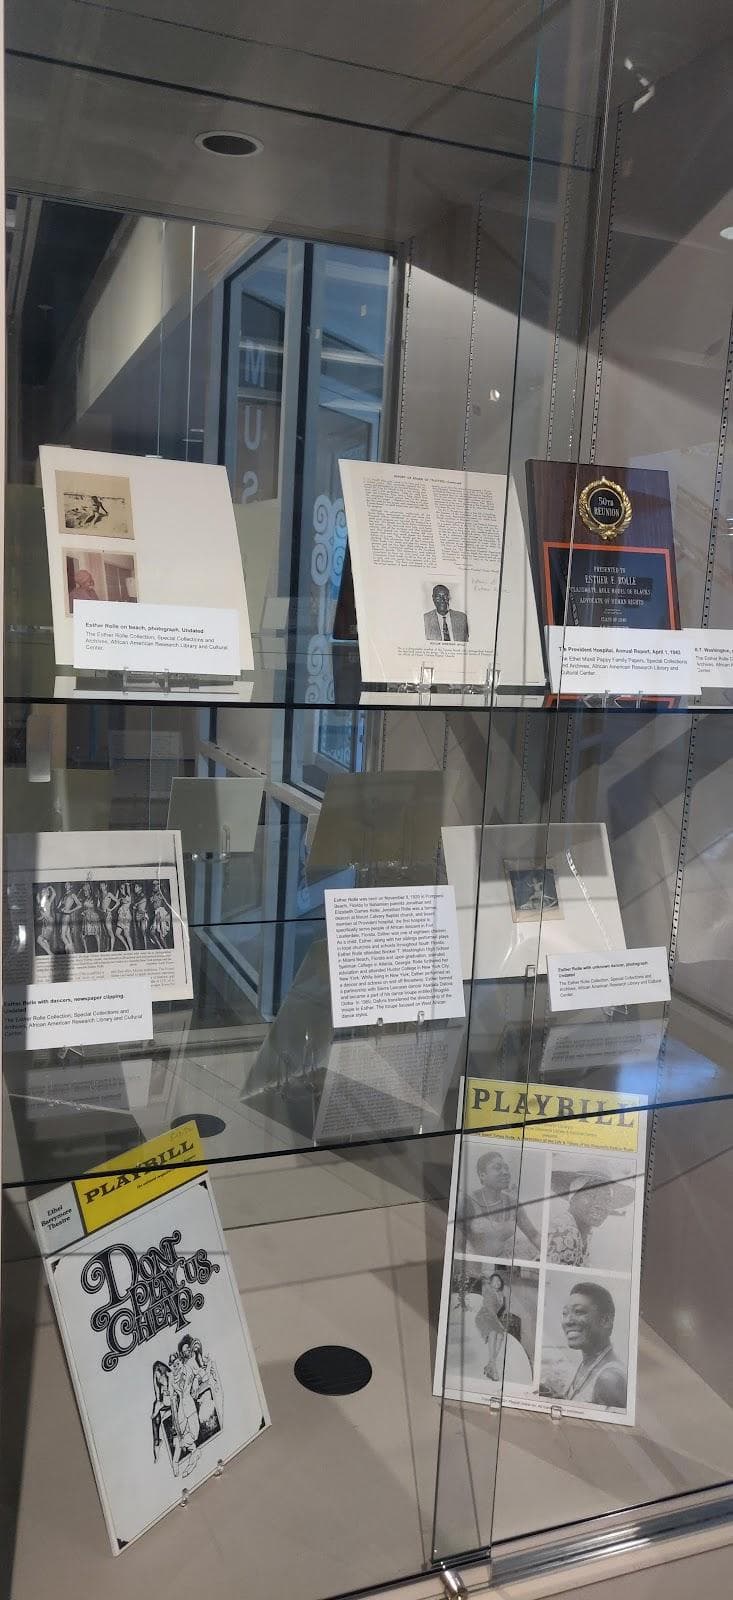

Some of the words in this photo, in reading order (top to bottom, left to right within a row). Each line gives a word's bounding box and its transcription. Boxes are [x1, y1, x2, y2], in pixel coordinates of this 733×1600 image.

[594, 507, 620, 518] REUNION
[585, 575, 608, 584] ESTHER
[618, 576, 637, 585] ROLLE
[472, 1088, 637, 1128] PLAYBILL
[47, 1205, 63, 1216] Ethel
[41, 1208, 73, 1227] Barrymore
[47, 1216, 71, 1231] Theatre
